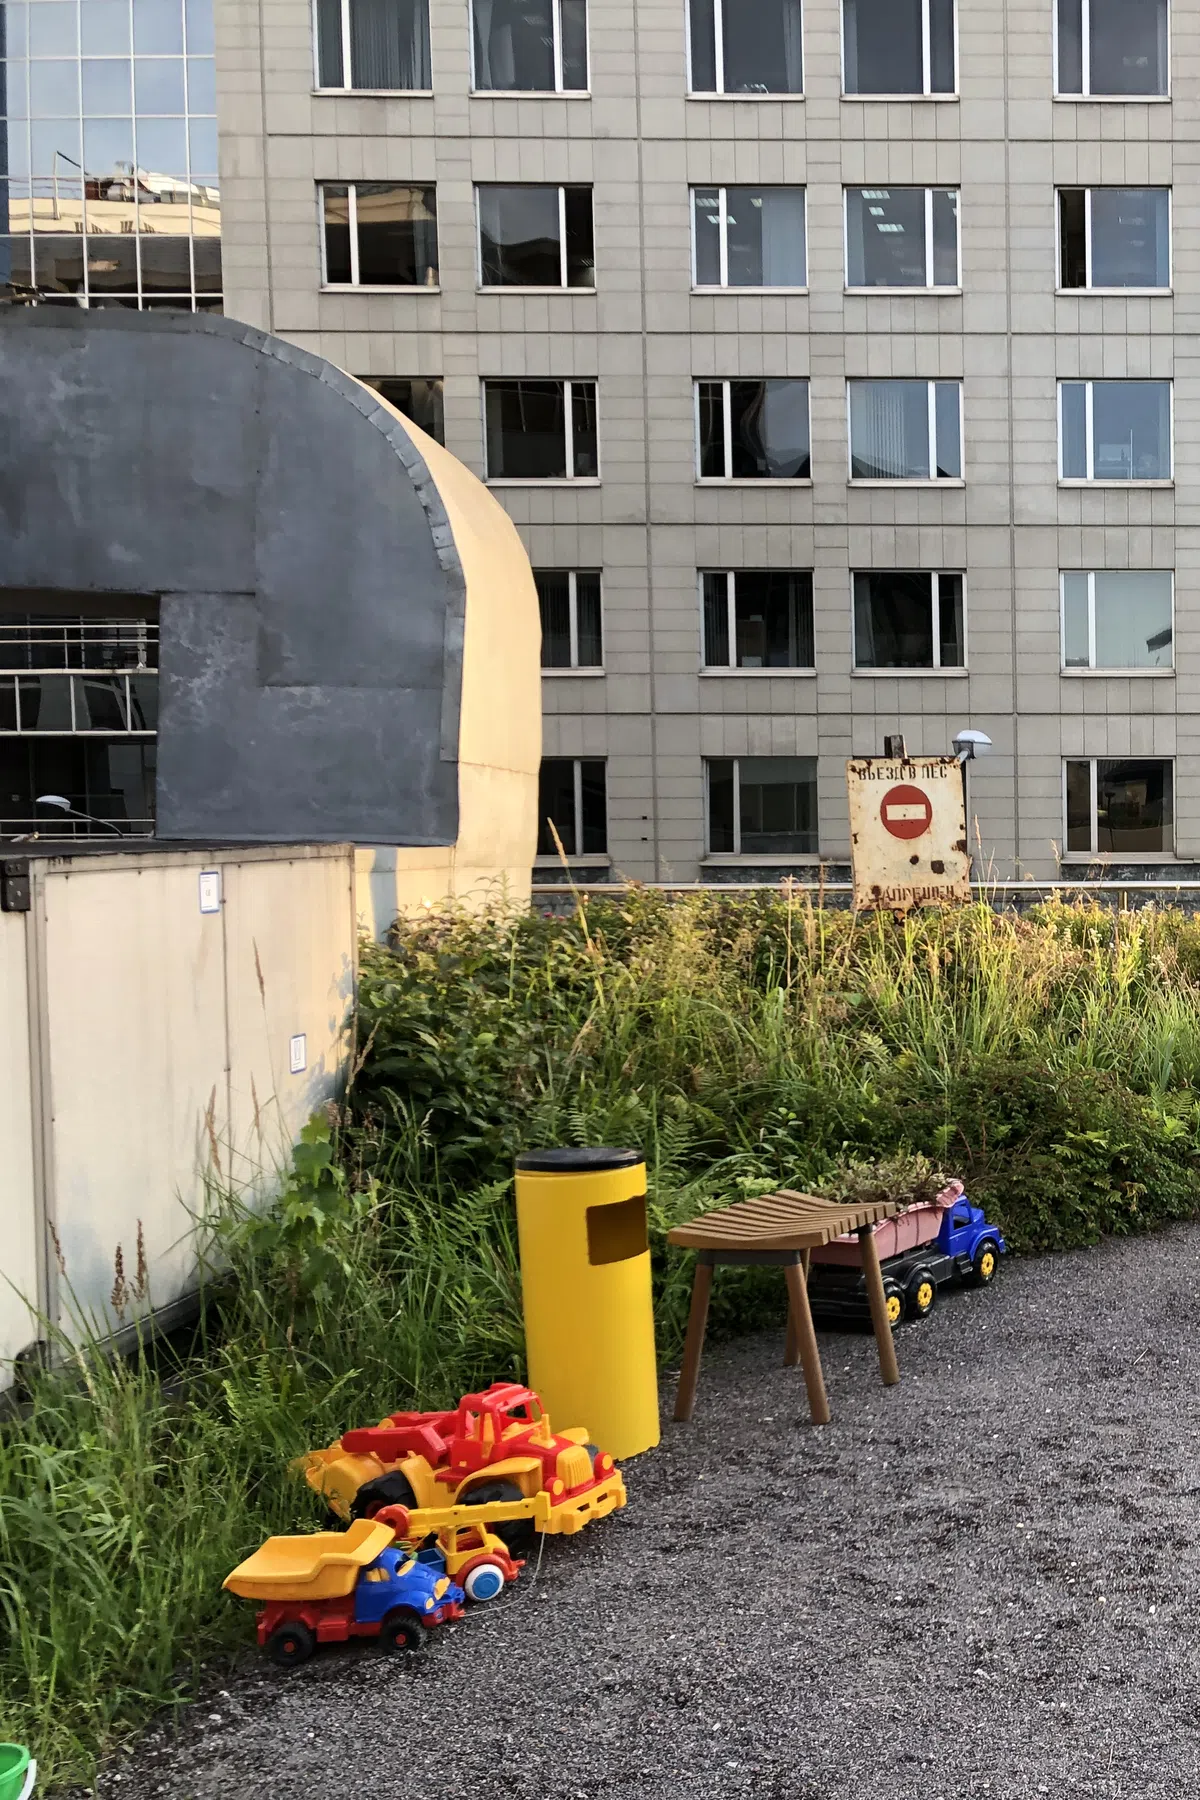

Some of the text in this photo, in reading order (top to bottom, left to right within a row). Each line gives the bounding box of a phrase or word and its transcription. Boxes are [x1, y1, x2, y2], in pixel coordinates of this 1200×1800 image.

[908, 766, 917, 779] В
[922, 764, 948, 779] ЛЕС
[869, 885, 956, 902] АПРЕЩЕН
